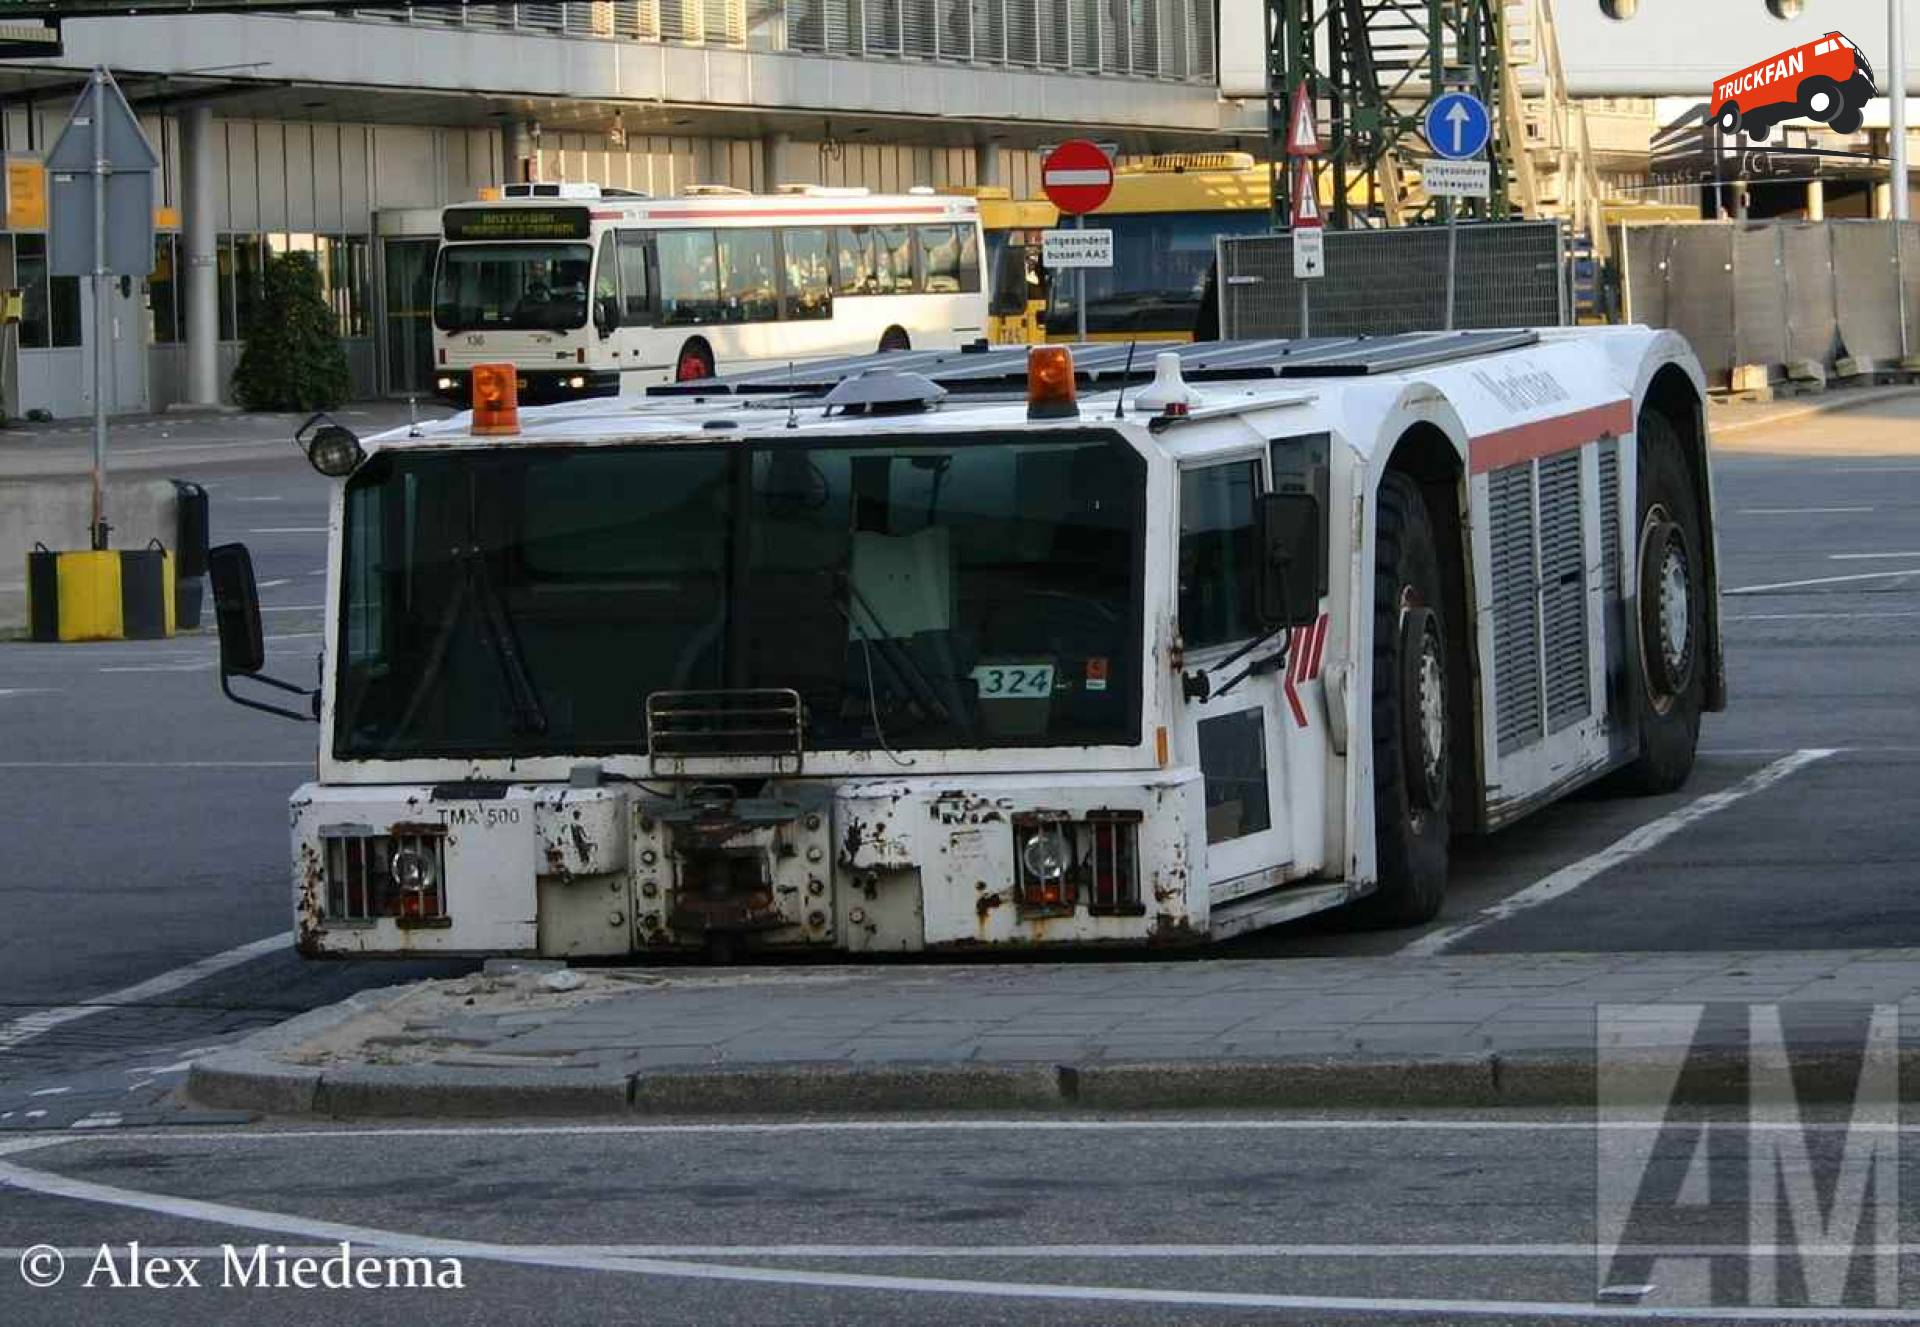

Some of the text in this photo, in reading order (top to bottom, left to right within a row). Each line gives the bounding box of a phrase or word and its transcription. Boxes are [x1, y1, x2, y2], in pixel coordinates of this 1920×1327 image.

[1045, 236, 1111, 249] uitgezonderd
[1047, 250, 1082, 260] bussen
[986, 670, 1047, 693] 324
[437, 807, 521, 826] TMX 500
